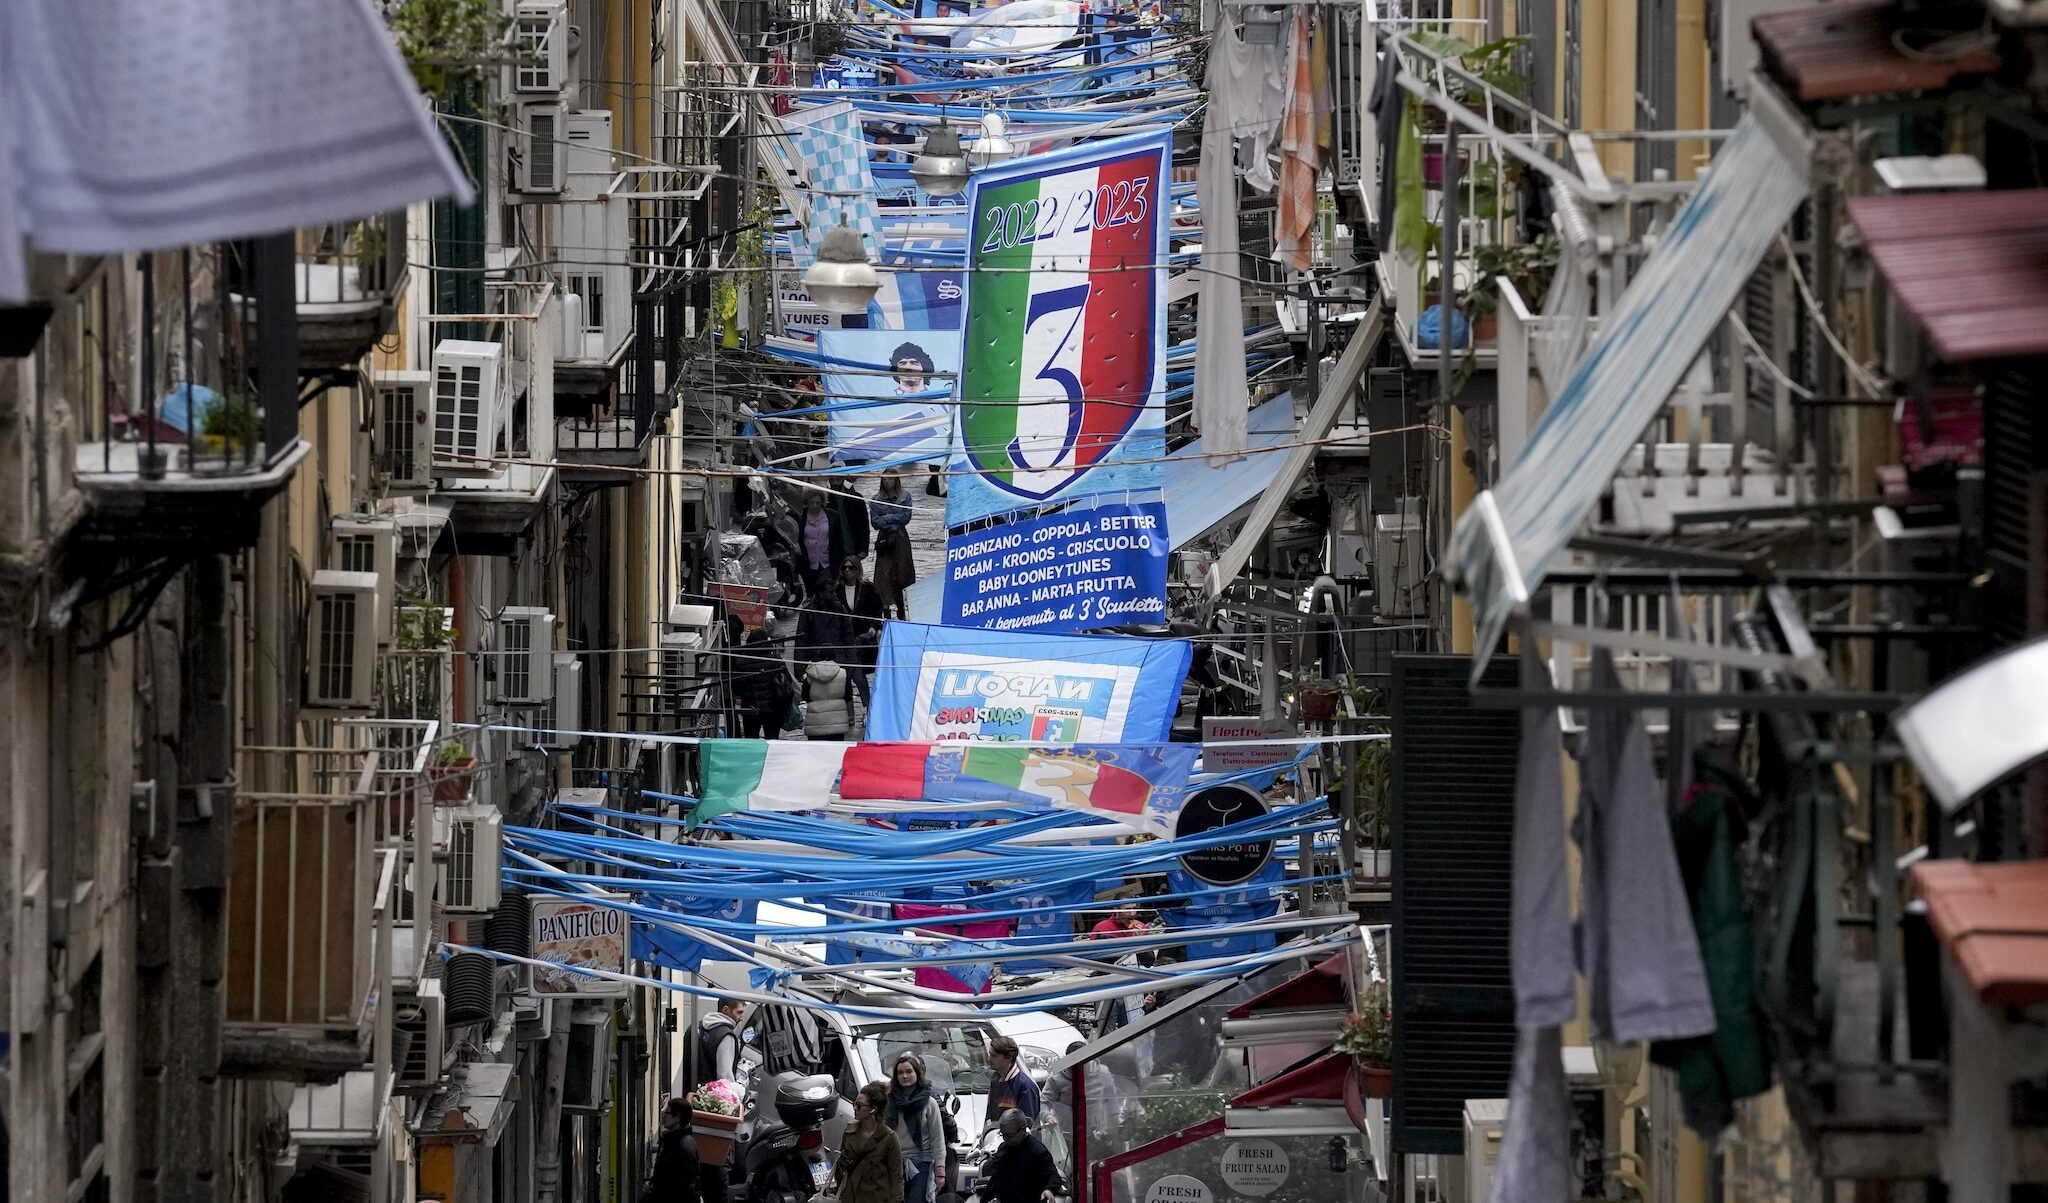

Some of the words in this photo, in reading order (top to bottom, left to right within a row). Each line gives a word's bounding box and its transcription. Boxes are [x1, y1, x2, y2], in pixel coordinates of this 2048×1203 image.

[981, 176, 1150, 254] 2022/2023
[785, 313, 829, 325] TUNES
[1006, 280, 1091, 474] 3
[947, 533, 1022, 563] FIORENZANO
[1032, 521, 1091, 544] COPPOLA
[1100, 515, 1156, 532] BETTER
[954, 558, 992, 581] BAGAM
[1002, 546, 1056, 570] KRONOS
[1066, 534, 1150, 558] CRISCUOLO
[978, 574, 1010, 594] BABY
[1011, 564, 1064, 588] LOONEY
[1066, 558, 1112, 577] TUNES
[962, 603, 984, 618] BAR
[985, 592, 1021, 612] ANNA
[1031, 584, 1076, 604] MARTA
[1076, 576, 1136, 594] FRUTTA
[996, 610, 1056, 630] benvenuto
[1058, 604, 1074, 620] al
[1097, 596, 1164, 620] Scudetto
[538, 909, 619, 943] PANIFICIO
[1226, 1163, 1254, 1172] FRUIT
[1256, 1164, 1286, 1174] SALAD
[1238, 1148, 1273, 1158] FRESH
[1158, 1186, 1202, 1198] FRESH
